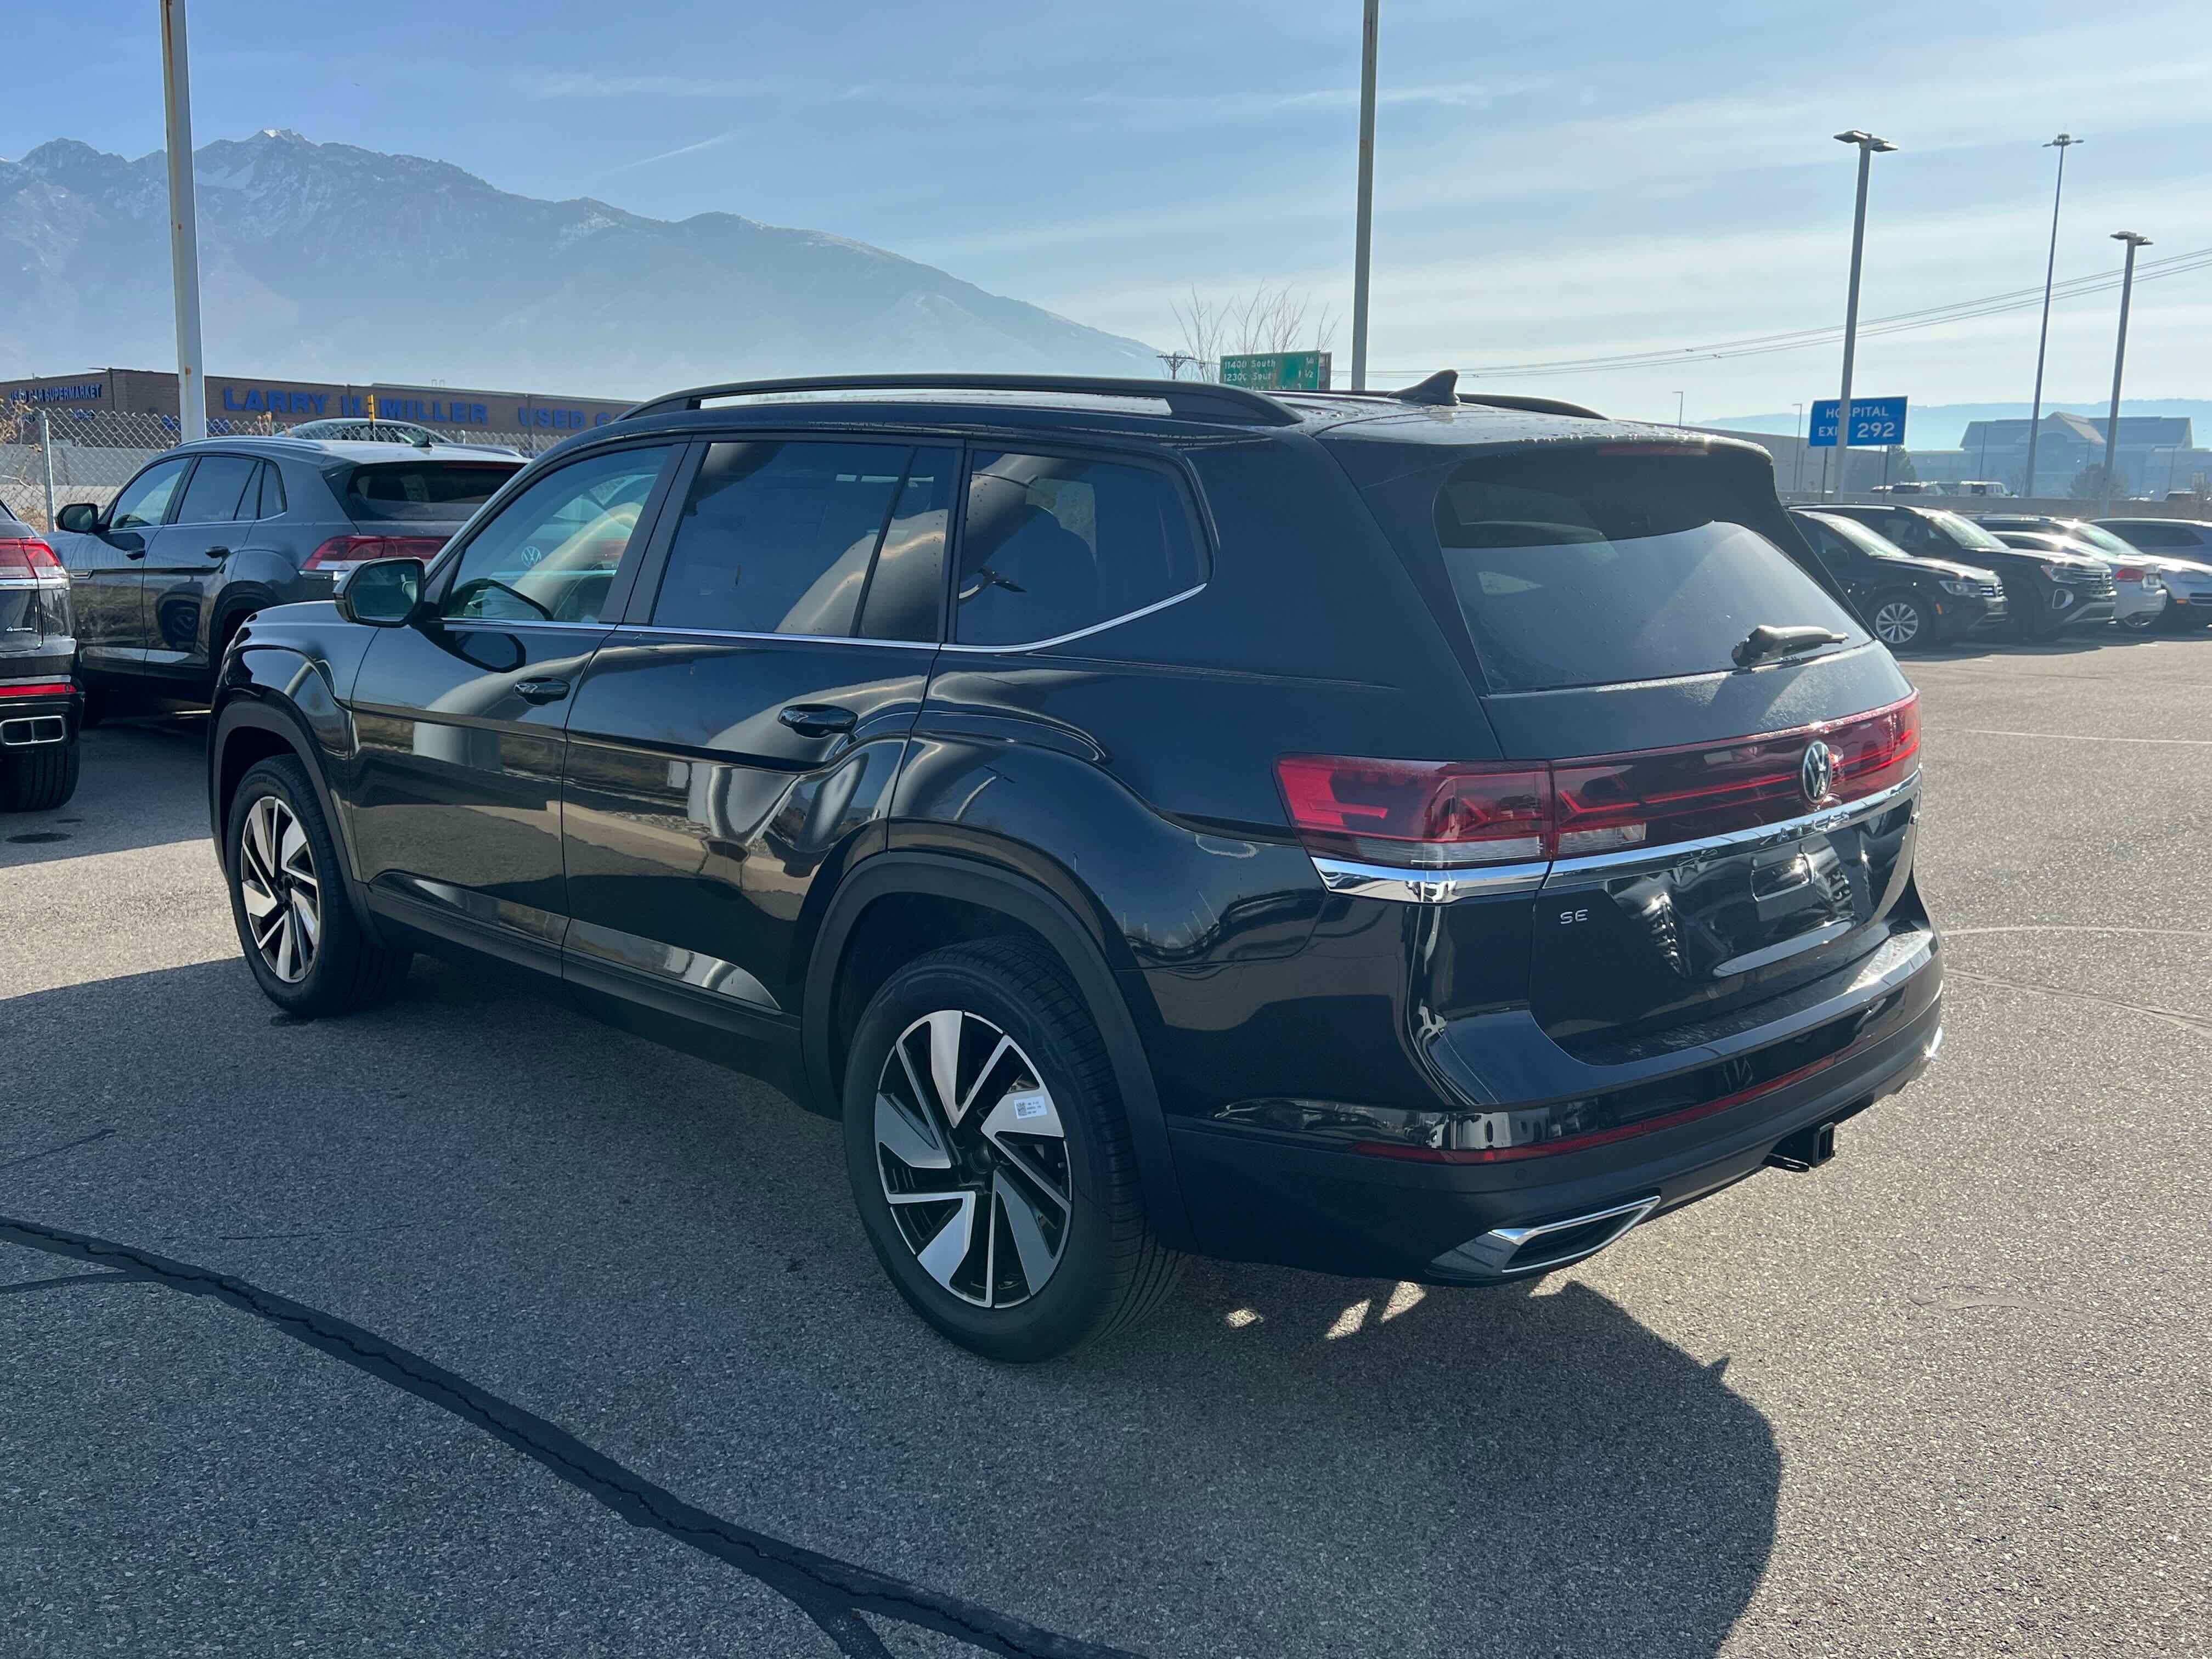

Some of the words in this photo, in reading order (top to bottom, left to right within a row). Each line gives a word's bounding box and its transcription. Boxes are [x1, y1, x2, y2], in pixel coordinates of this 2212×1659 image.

[1251, 359, 1276, 368] South
[44, 383, 103, 402] SUPERMARKET
[224, 386, 328, 414] LARRY
[379, 398, 489, 424] MILLER
[518, 406, 586, 430] USED
[1826, 407, 1889, 419] HOPITAL
[1818, 426, 1838, 437] EXI
[1857, 422, 1895, 438] 292
[1560, 909, 1588, 924] SE
